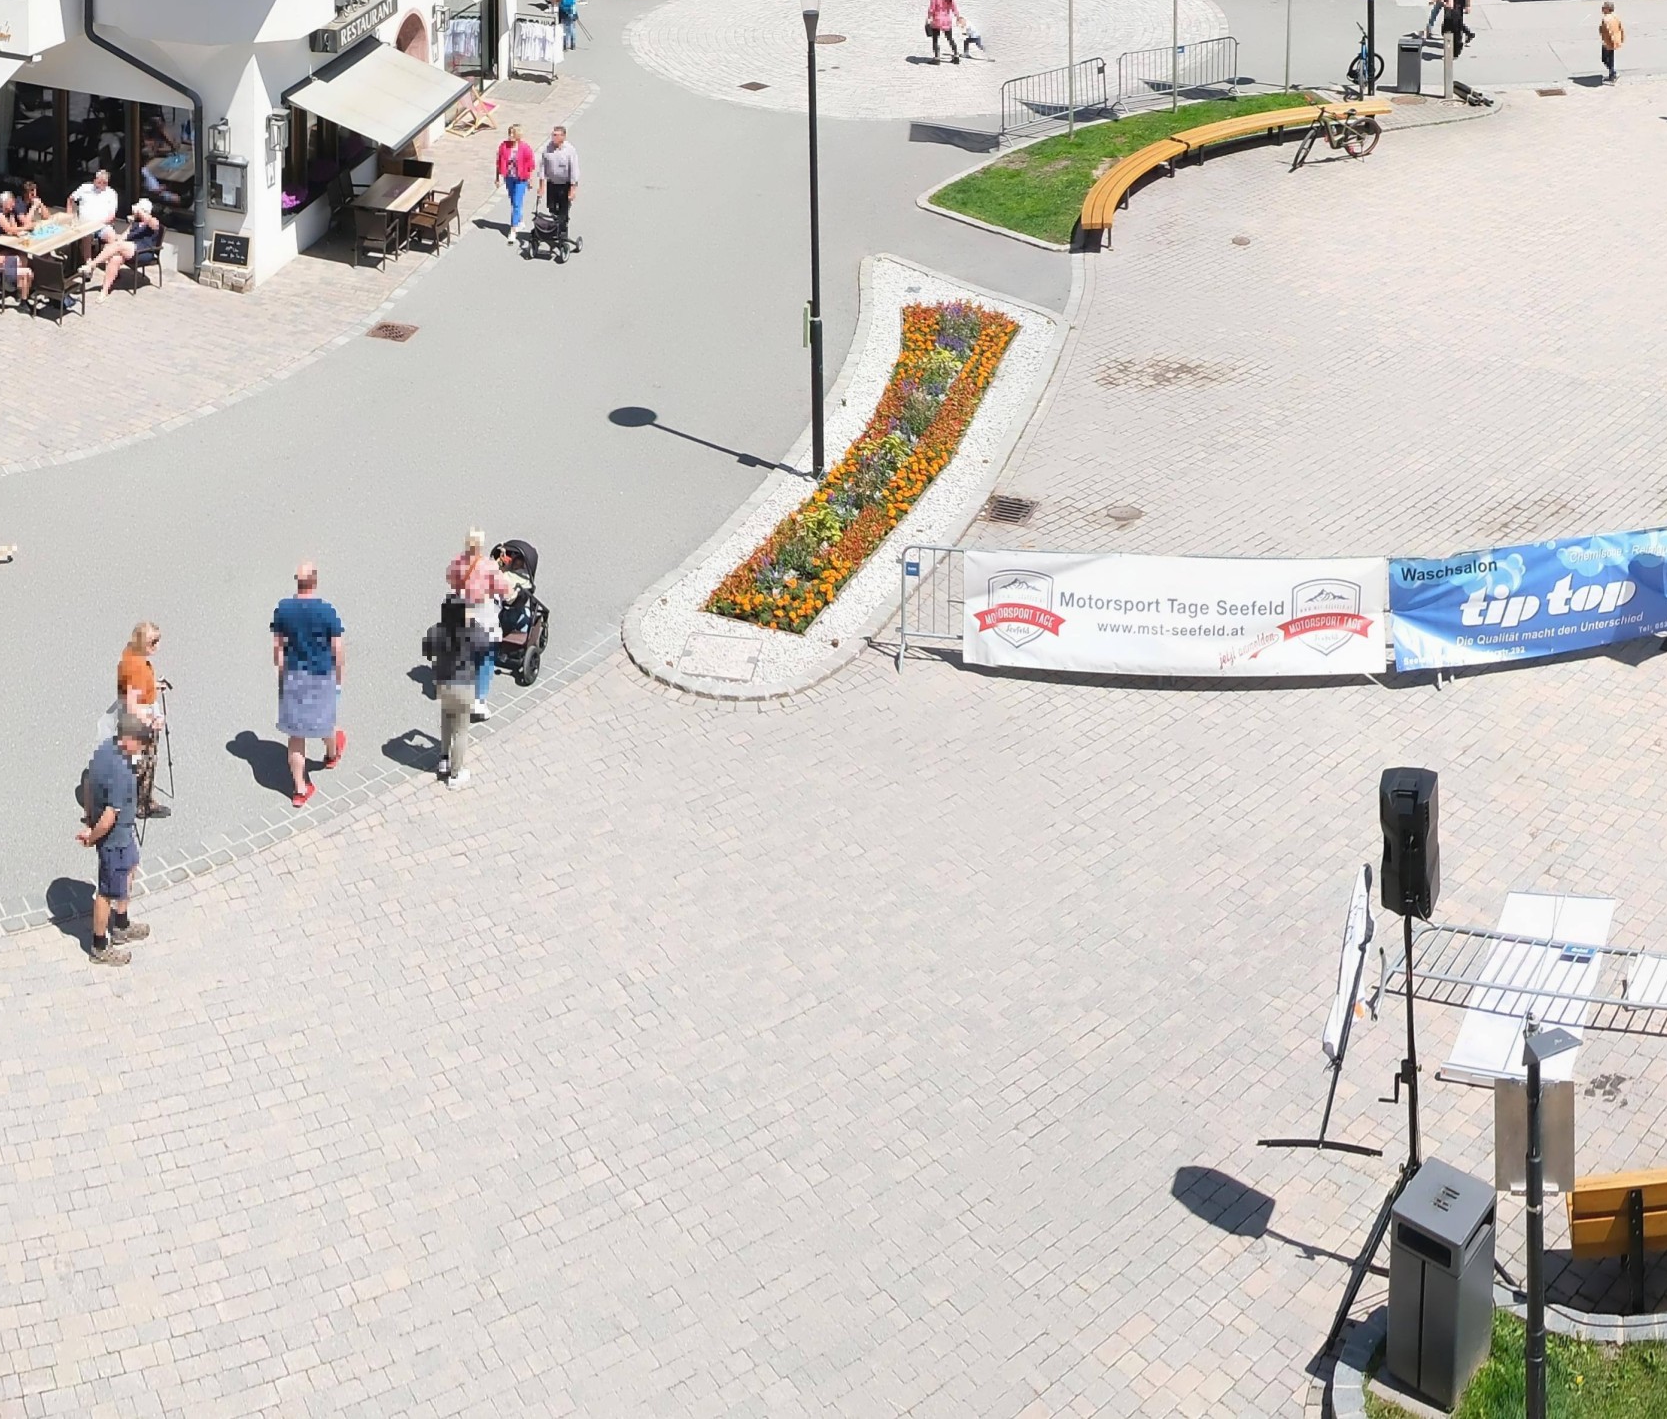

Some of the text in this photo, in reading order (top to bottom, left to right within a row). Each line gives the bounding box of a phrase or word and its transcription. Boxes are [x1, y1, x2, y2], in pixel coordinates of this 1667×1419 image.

[1401, 559, 1498, 582] Waschsalon
[1060, 591, 1161, 614] Motorsport
[1167, 598, 1210, 616] Tage
[1216, 599, 1285, 617] Seefeld
[1460, 573, 1636, 627] tip top
[1035, 611, 1056, 628] TAGE
[1097, 621, 1245, 637] www.mst-seefeld.at
[1288, 616, 1342, 634] MOTORSPORT
[1456, 612, 1643, 647] Die Qualität macht den Unterschied
